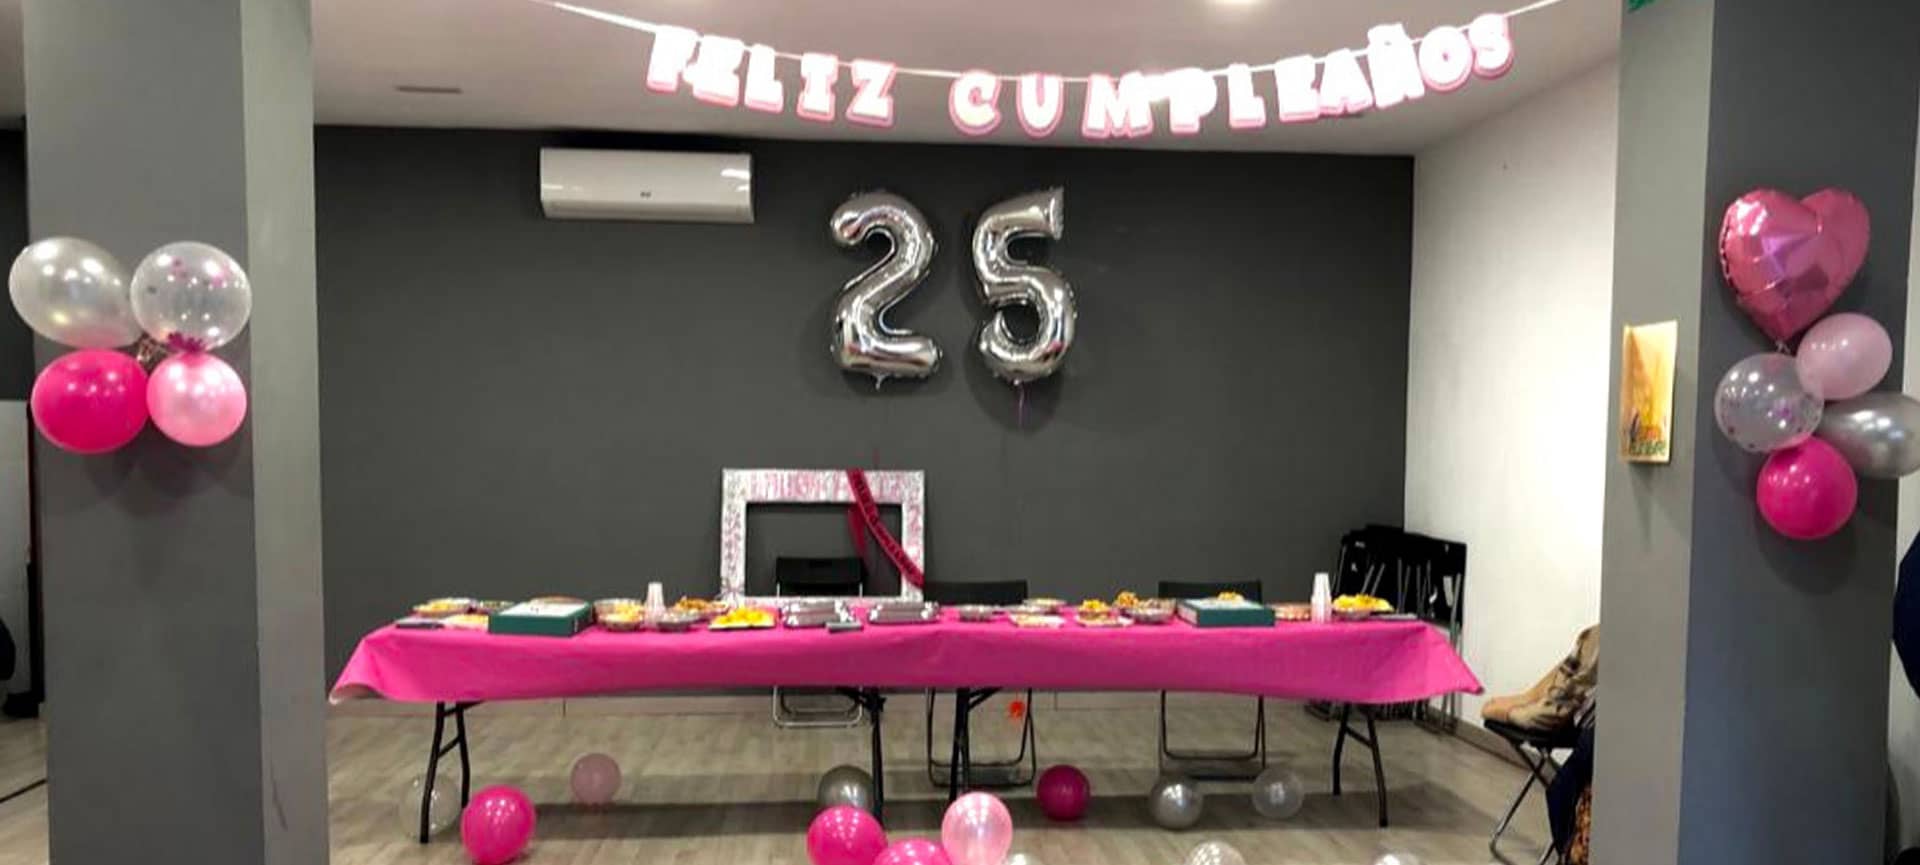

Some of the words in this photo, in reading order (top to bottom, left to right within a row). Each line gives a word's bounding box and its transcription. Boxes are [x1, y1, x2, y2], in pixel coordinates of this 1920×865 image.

[647, 25, 896, 127] FELIZ
[949, 14, 1515, 138] CUMPLEAÑOS
[831, 188, 1077, 384] 25
